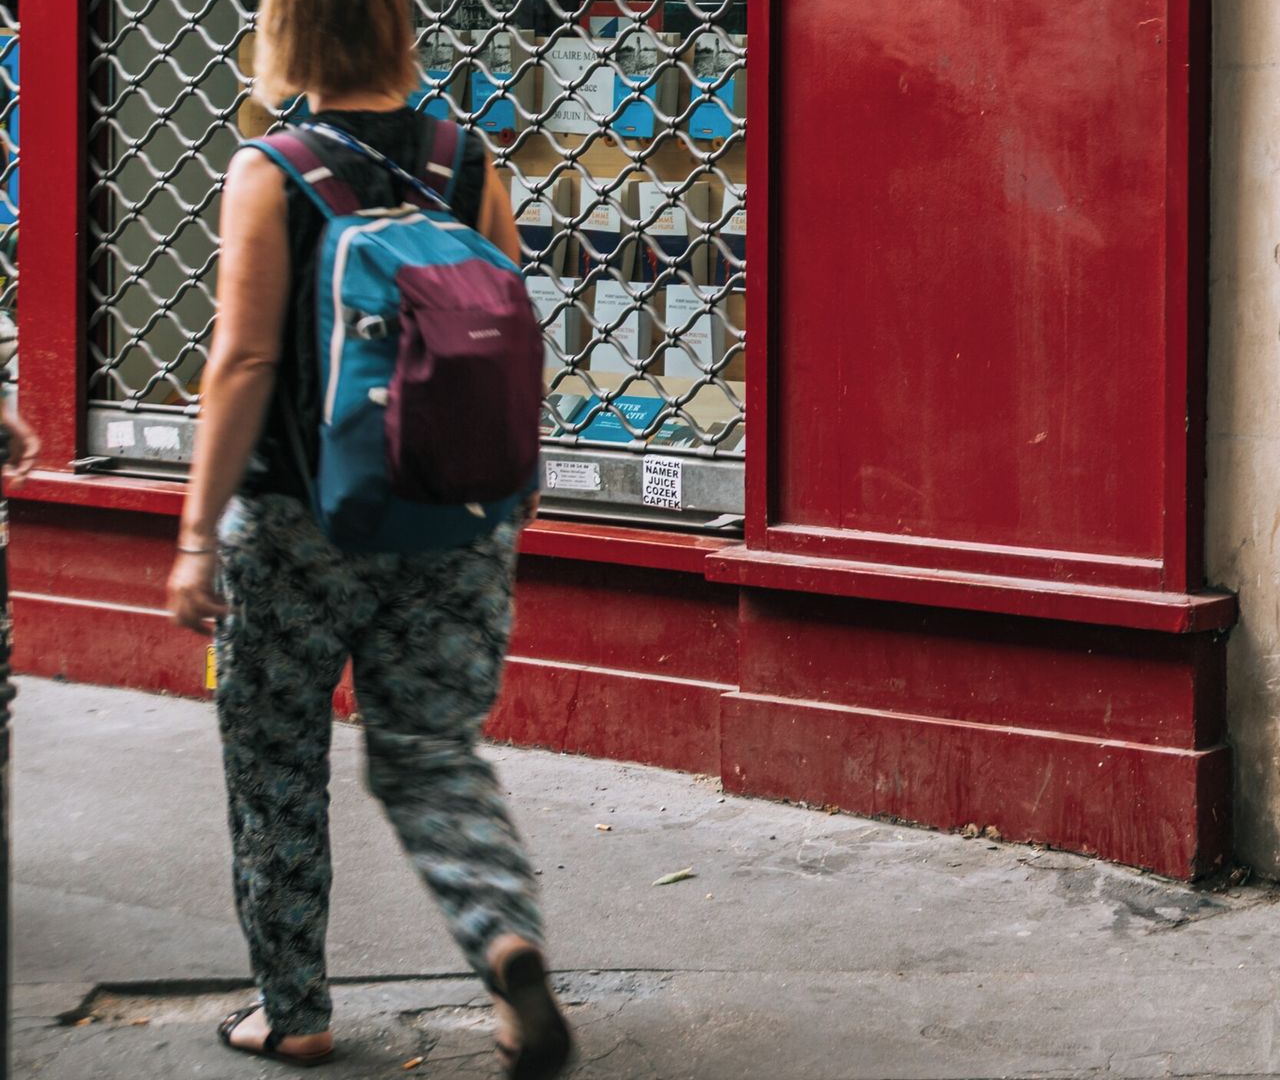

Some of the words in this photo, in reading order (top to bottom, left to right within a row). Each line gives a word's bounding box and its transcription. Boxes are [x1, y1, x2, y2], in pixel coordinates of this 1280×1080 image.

[551, 50, 582, 62] CLAIRE
[645, 467, 679, 479] NAMER
[648, 476, 676, 489] JUICE
[645, 485, 678, 499] COZEK
[643, 495, 681, 510] CAPTEK
